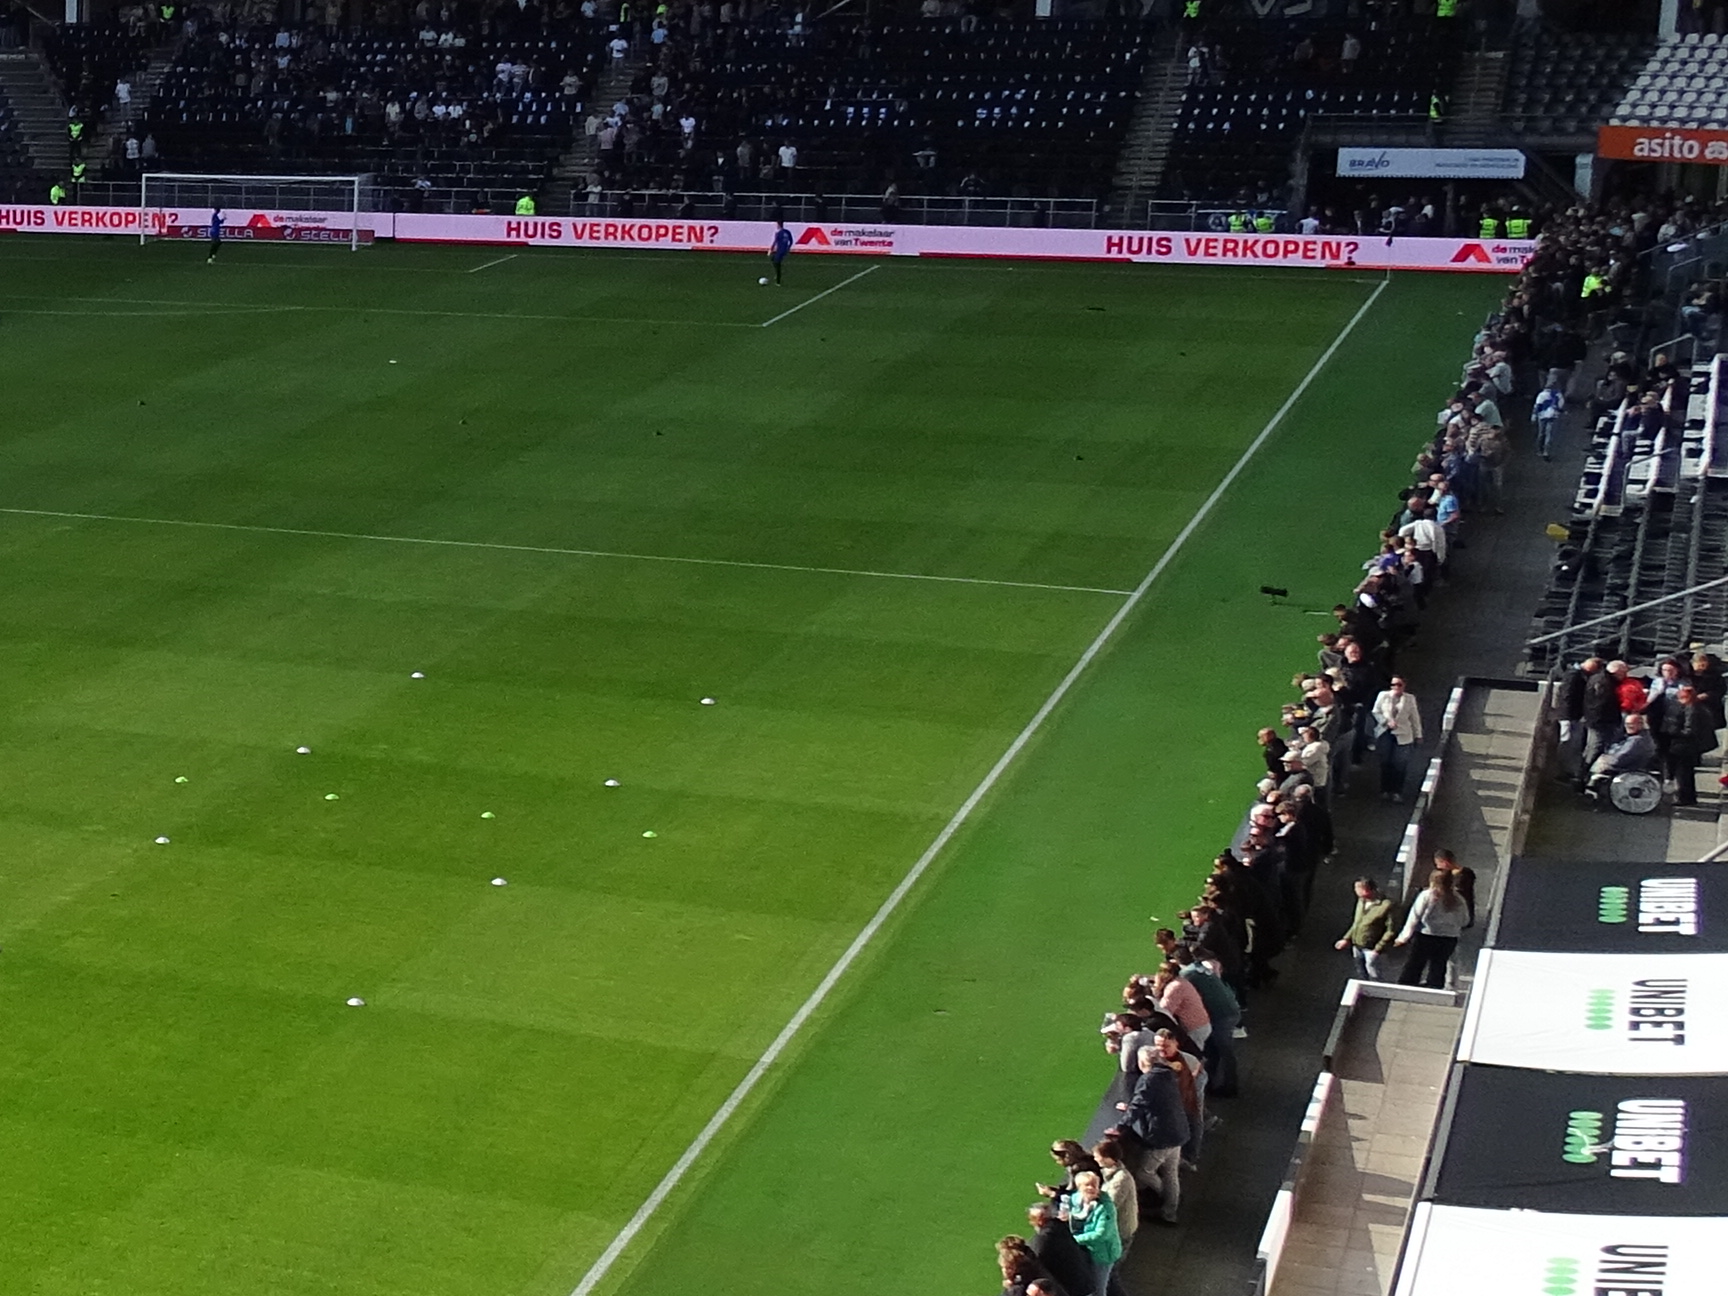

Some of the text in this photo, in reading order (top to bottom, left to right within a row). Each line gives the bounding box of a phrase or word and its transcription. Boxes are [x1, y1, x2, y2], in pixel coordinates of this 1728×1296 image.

[1633, 132, 1700, 159] asito
[53, 211, 179, 230] VERKOPEN?
[506, 220, 719, 244] HUIS VERKOPEN?
[830, 229, 895, 238] de makelaar
[834, 237, 894, 247] van Twente
[1105, 235, 1359, 263] HUIS VERKOPEN?
[1637, 877, 1699, 936] UNIBET
[1627, 978, 1689, 1046] UNIBET
[1610, 1099, 1685, 1184] UNIBET
